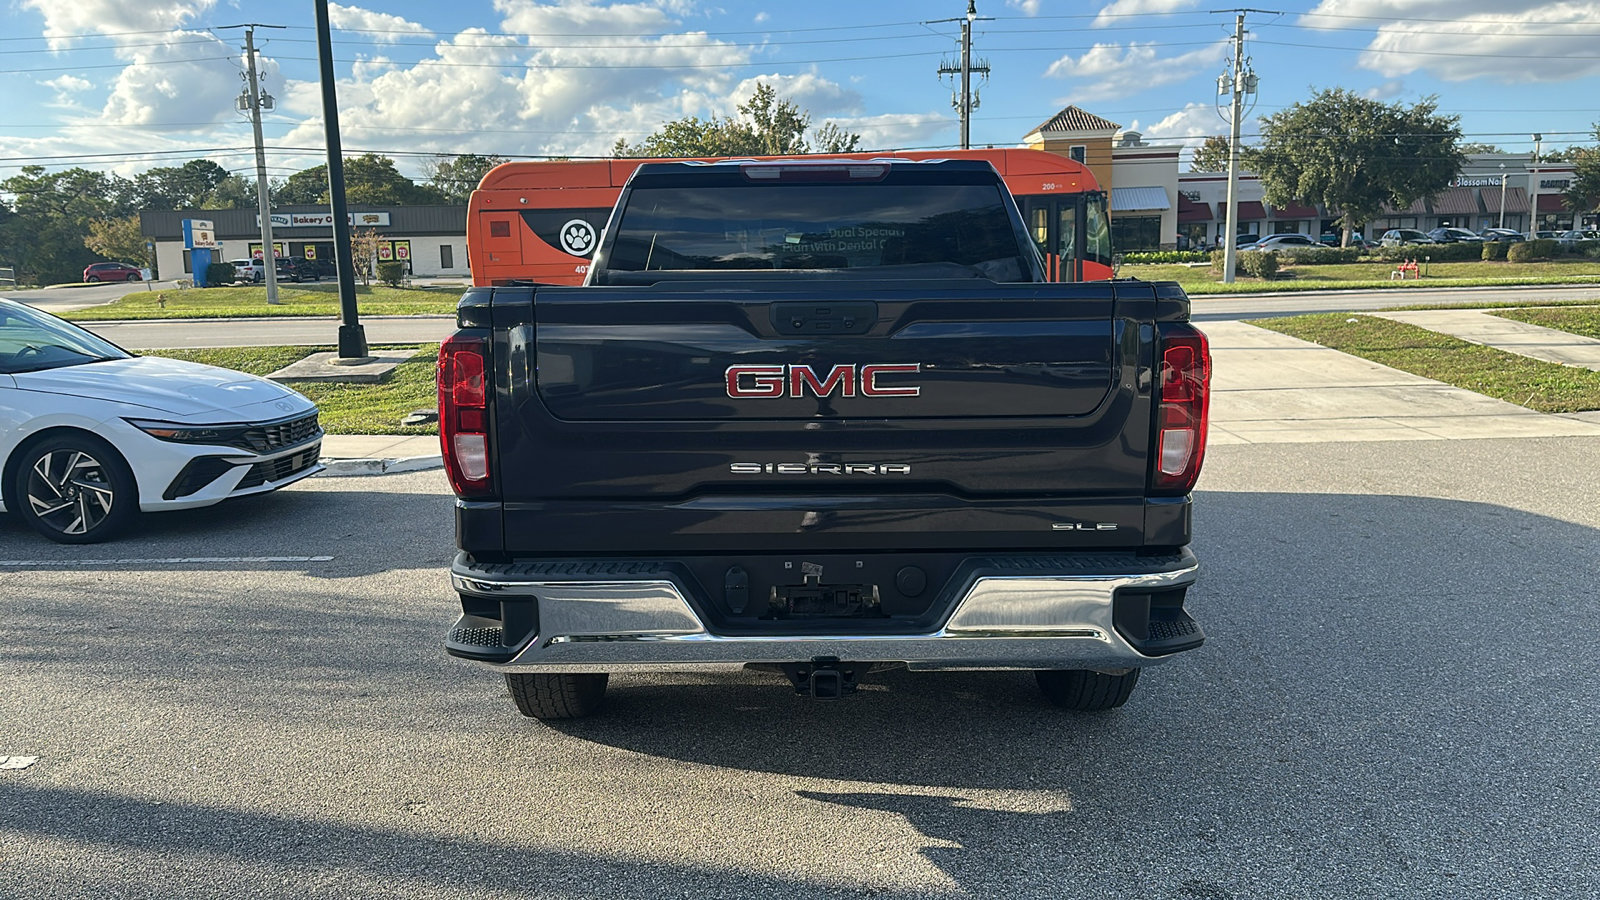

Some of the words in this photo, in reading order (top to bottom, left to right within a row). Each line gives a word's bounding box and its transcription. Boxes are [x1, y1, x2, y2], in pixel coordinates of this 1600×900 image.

[293, 216, 323, 225] Bakery
[829, 226, 855, 238] Dual
[838, 238, 876, 251] Dental
[724, 362, 921, 399] GMC
[730, 462, 912, 475] SIERRA
[1051, 522, 1119, 531] SLE
